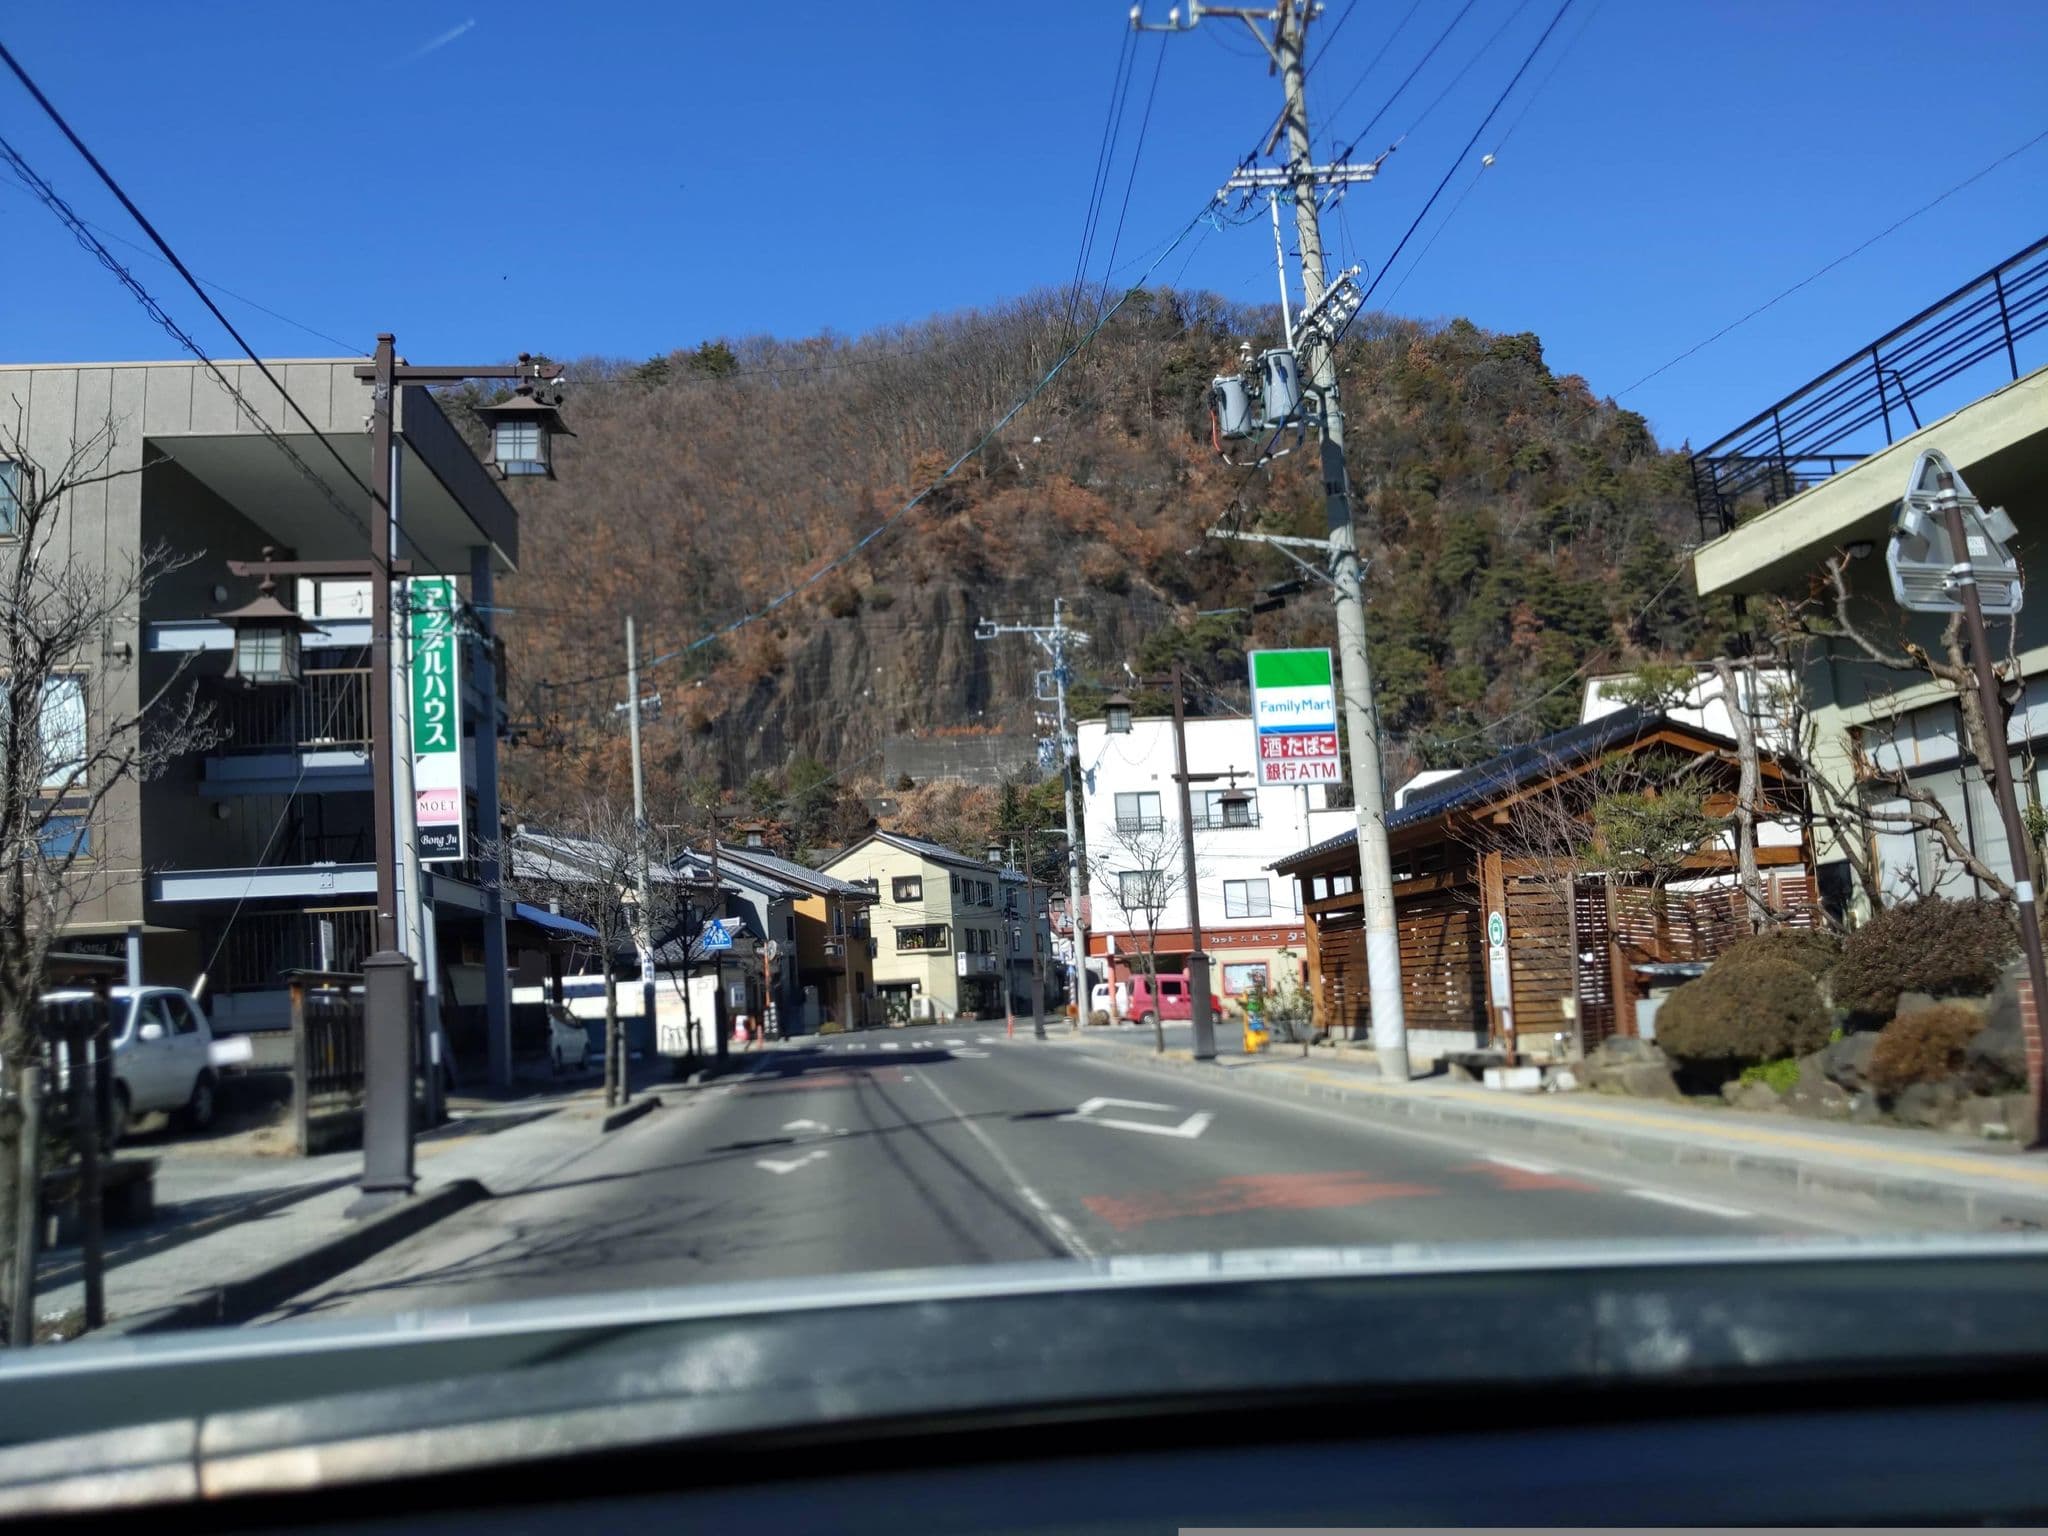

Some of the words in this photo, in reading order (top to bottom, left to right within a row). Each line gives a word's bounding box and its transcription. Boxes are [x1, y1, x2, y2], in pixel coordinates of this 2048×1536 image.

[1260, 699, 1331, 714] FamilyMart
[1266, 762, 1336, 780] 銀行ATM
[420, 835, 444, 847] Bong
